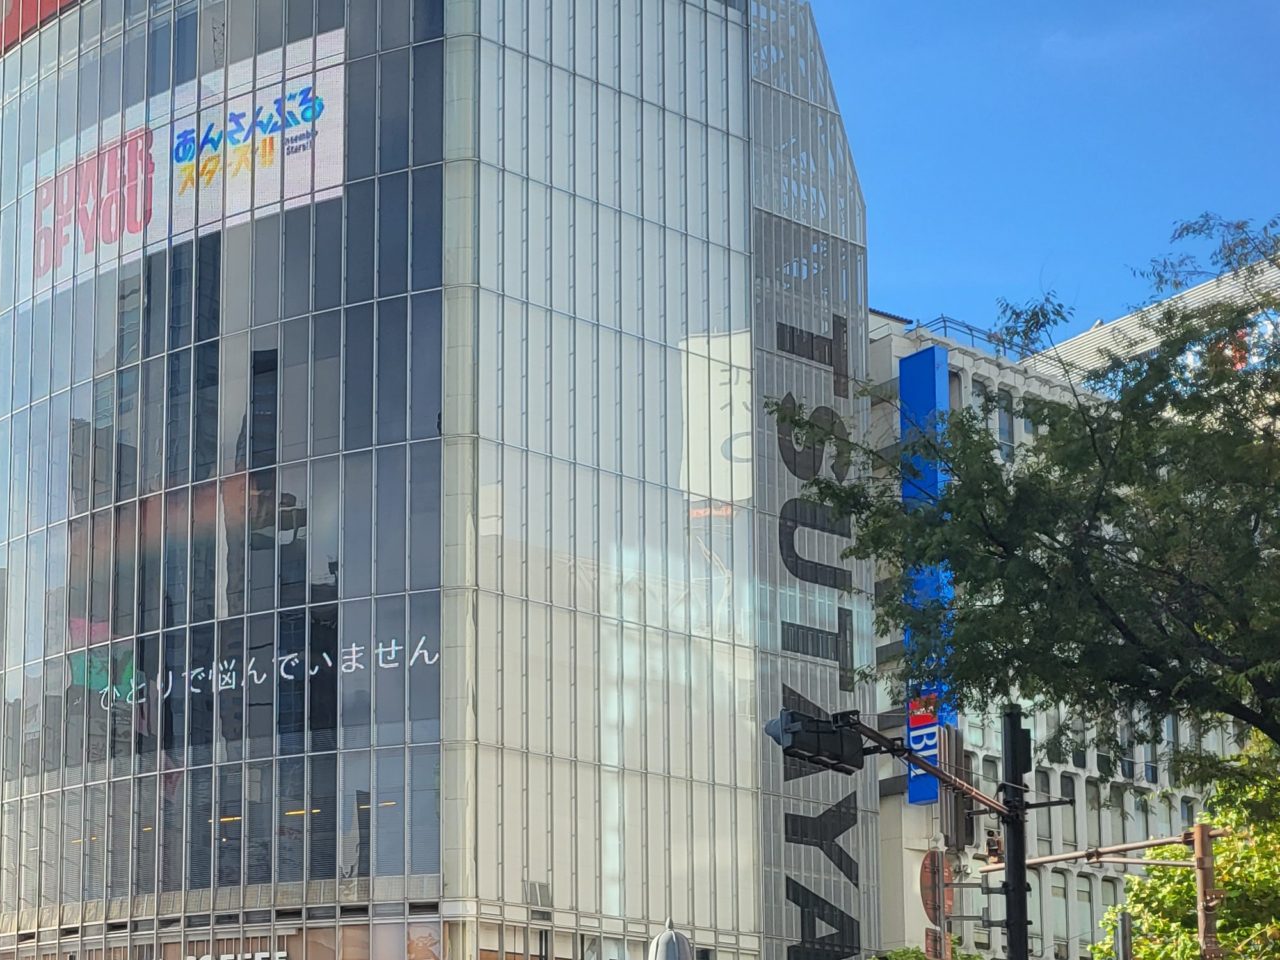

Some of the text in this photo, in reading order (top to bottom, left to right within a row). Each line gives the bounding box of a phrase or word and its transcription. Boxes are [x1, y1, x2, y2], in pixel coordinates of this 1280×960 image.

[174, 86, 325, 163] あんさんぶる
[78, 174, 154, 255] YOU
[99, 636, 441, 711] ひとりで悩んでいません
